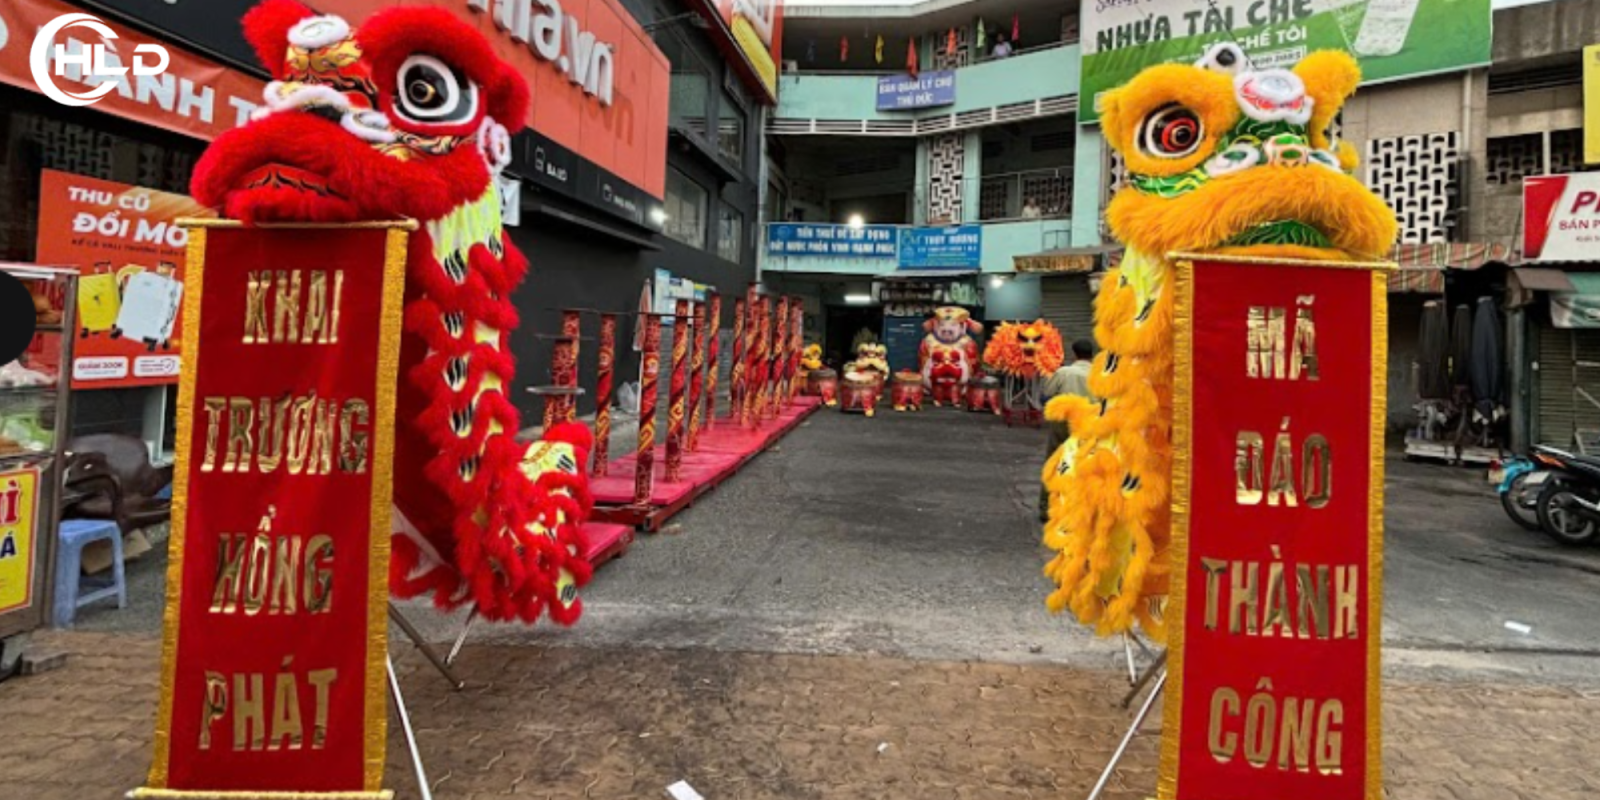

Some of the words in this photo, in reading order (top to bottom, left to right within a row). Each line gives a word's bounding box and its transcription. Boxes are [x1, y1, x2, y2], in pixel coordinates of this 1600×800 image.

[1276, 25, 1307, 44] TÔI
[68, 186, 113, 206] THU
[118, 194, 149, 212] CŨ
[72, 210, 130, 237] ĐỔI
[1559, 218, 1589, 231] BÁN
[242, 269, 343, 344] KHAI
[1246, 294, 1320, 381] MÃ
[200, 389, 369, 475] TRƯƠNG
[1201, 544, 1359, 640] THÀNH
[198, 655, 338, 751] PHÁT
[1208, 677, 1344, 776] CÔNG
